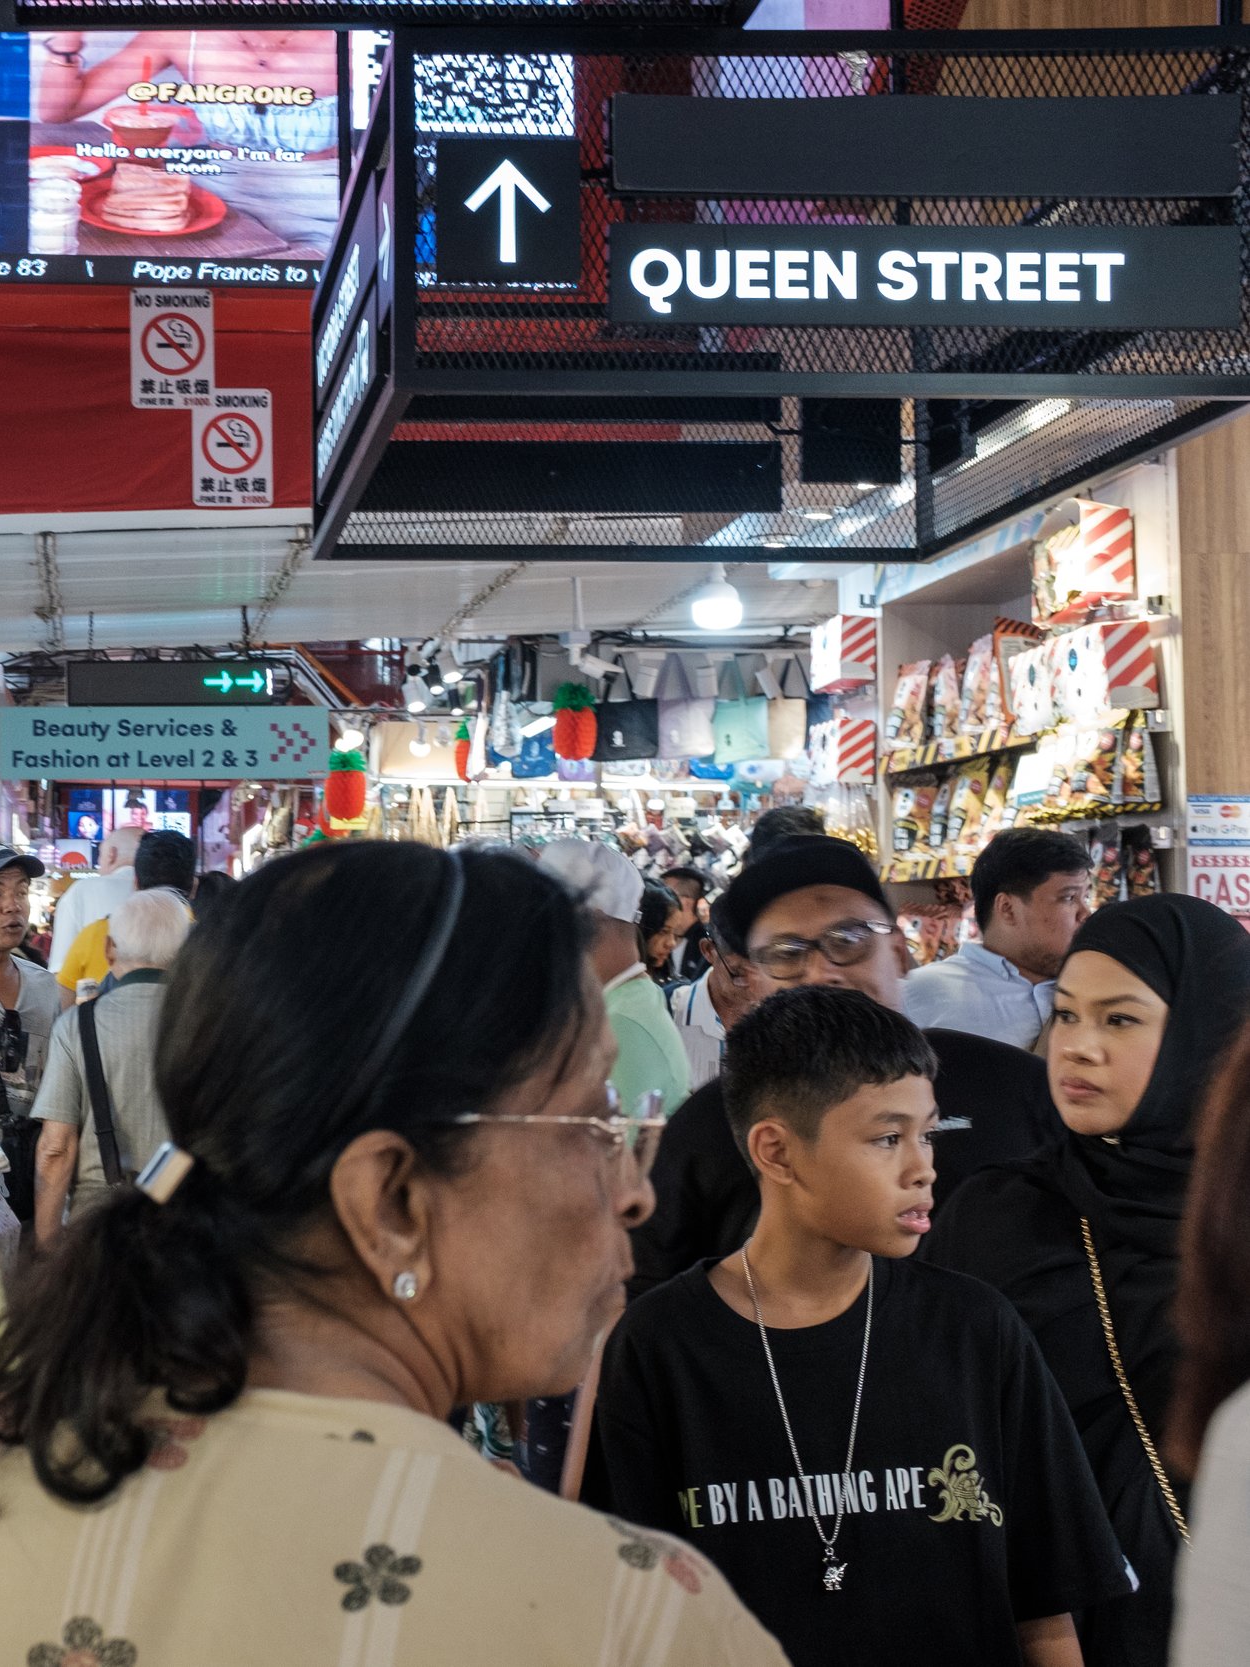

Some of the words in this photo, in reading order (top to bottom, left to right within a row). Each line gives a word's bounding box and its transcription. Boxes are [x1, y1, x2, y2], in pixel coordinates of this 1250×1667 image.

[126, 81, 315, 106] @FANGRONG
[75, 142, 130, 158] Hello
[135, 147, 232, 163] everyone
[237, 147, 271, 161] I'm
[16, 258, 48, 276] 83
[132, 260, 192, 283] Pope
[197, 262, 281, 282] Francis
[285, 265, 308, 282] to
[629, 247, 858, 314] QUEEN
[876, 249, 1126, 302] STREET
[134, 294, 152, 308] NO
[154, 294, 211, 309] SMOKING
[140, 379, 210, 395] 禁止吸烟
[215, 395, 268, 408] SMOKING
[200, 477, 267, 493] 禁止吸烟
[32, 719, 110, 742] Beauty
[117, 718, 214, 738] Services
[222, 719, 238, 737] &
[11, 749, 101, 768] Fashion
[106, 750, 130, 768] at
[137, 749, 195, 768] Level
[203, 750, 215, 768] 2
[221, 750, 238, 768] &
[245, 749, 258, 768] 3
[707, 1482, 738, 1525] BY
[748, 1480, 764, 1522] A
[768, 1470, 877, 1520] BATHING
[885, 1466, 927, 1511] APE
